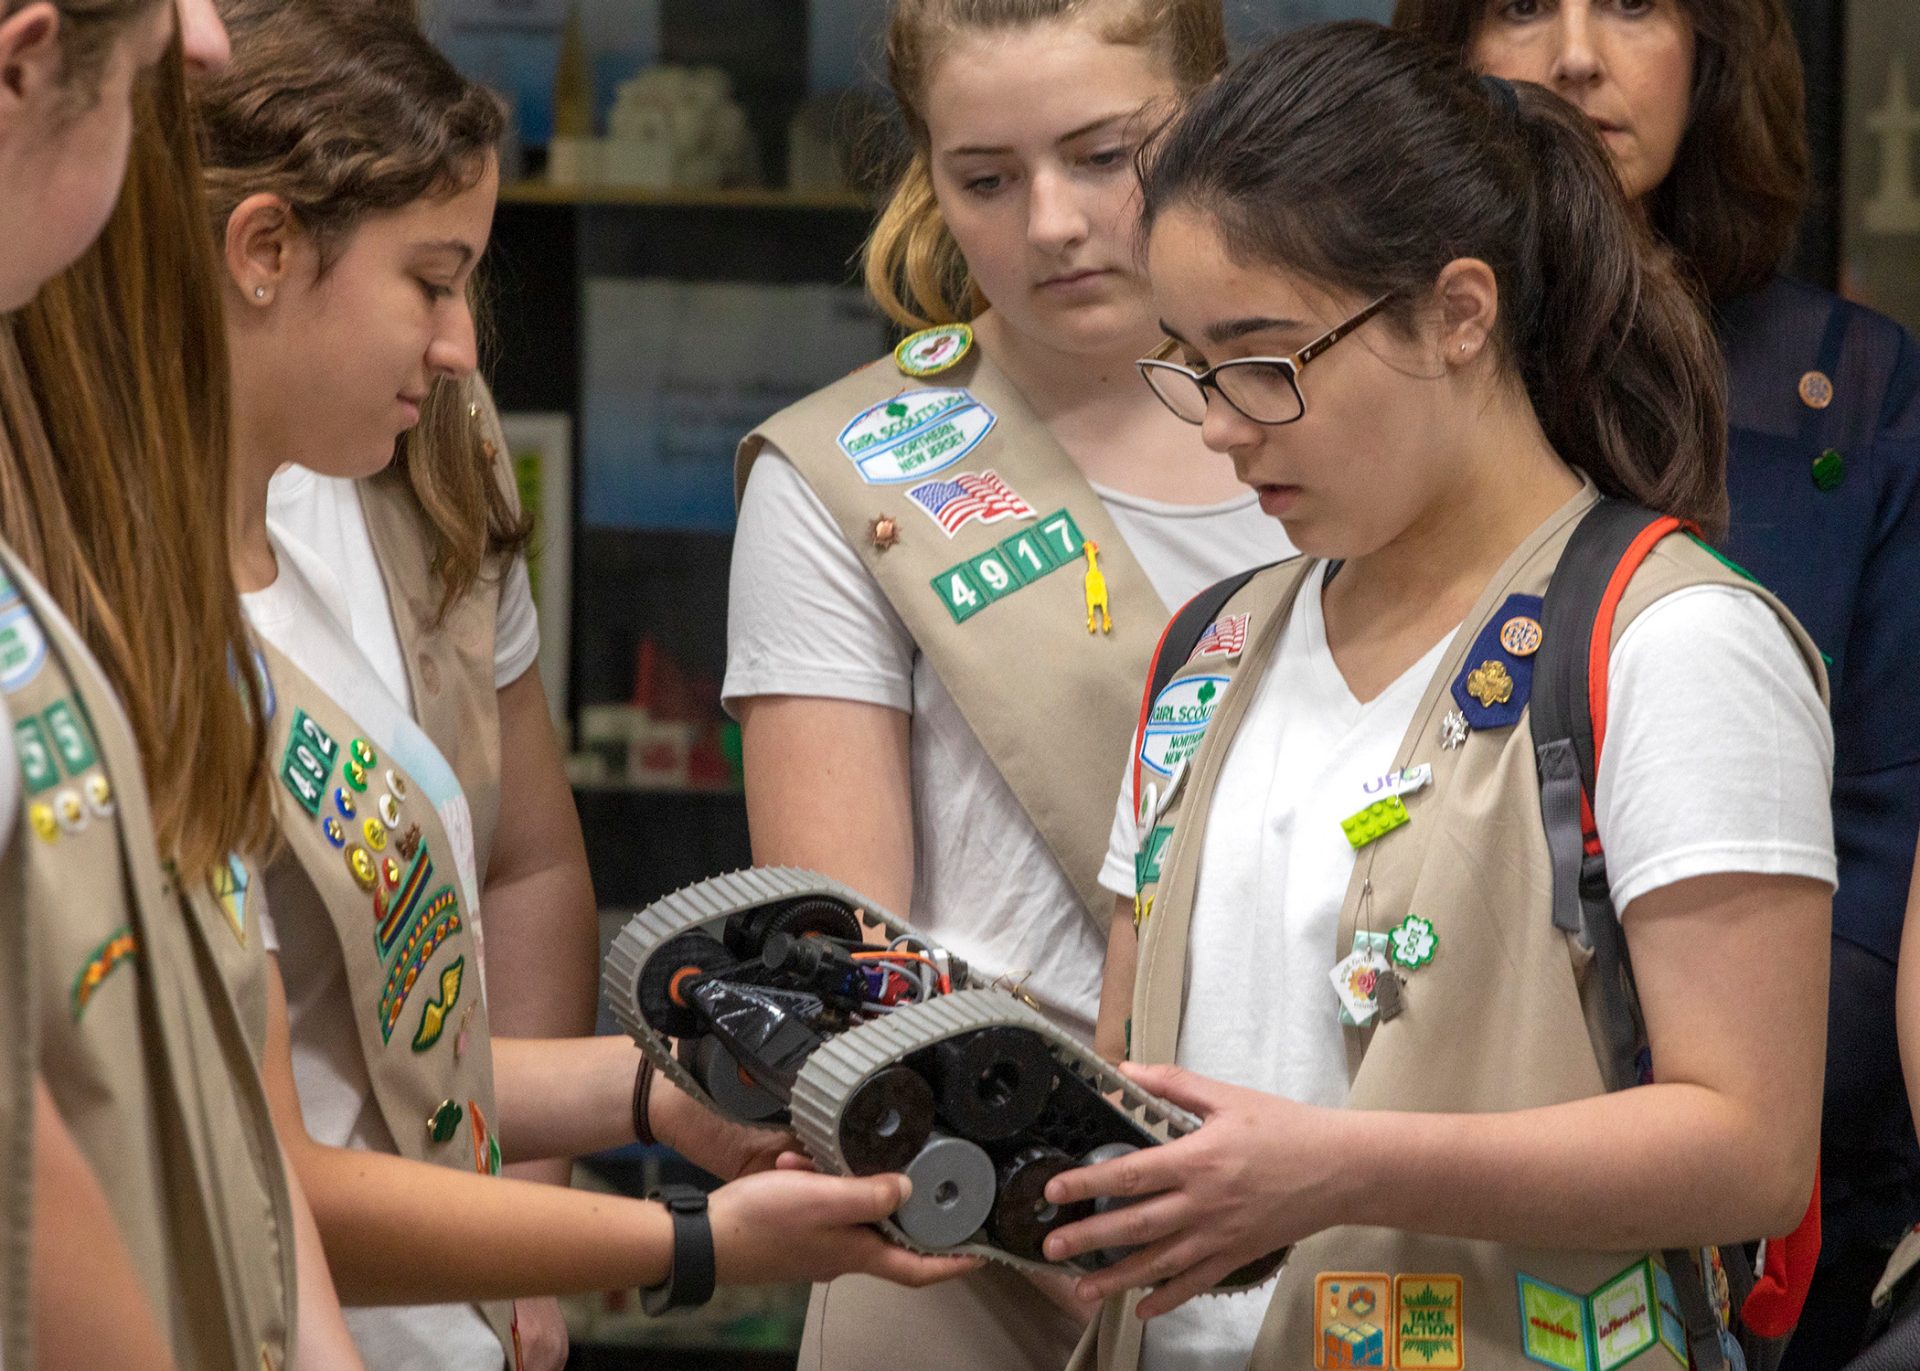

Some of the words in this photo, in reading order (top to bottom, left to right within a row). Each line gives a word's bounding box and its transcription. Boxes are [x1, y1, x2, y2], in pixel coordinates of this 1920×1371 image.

[847, 432, 880, 451] GIRL
[880, 403, 939, 439] SCOUTS
[892, 421, 955, 459] NORTHERN
[898, 451, 926, 473] NEW
[927, 430, 965, 459] JERSEY
[950, 518, 1074, 607] 4917
[1152, 705, 1176, 721] GIRL
[289, 718, 333, 801] 492
[1401, 1322, 1454, 1335] ACTION
[1410, 1311, 1445, 1325] TAKE
